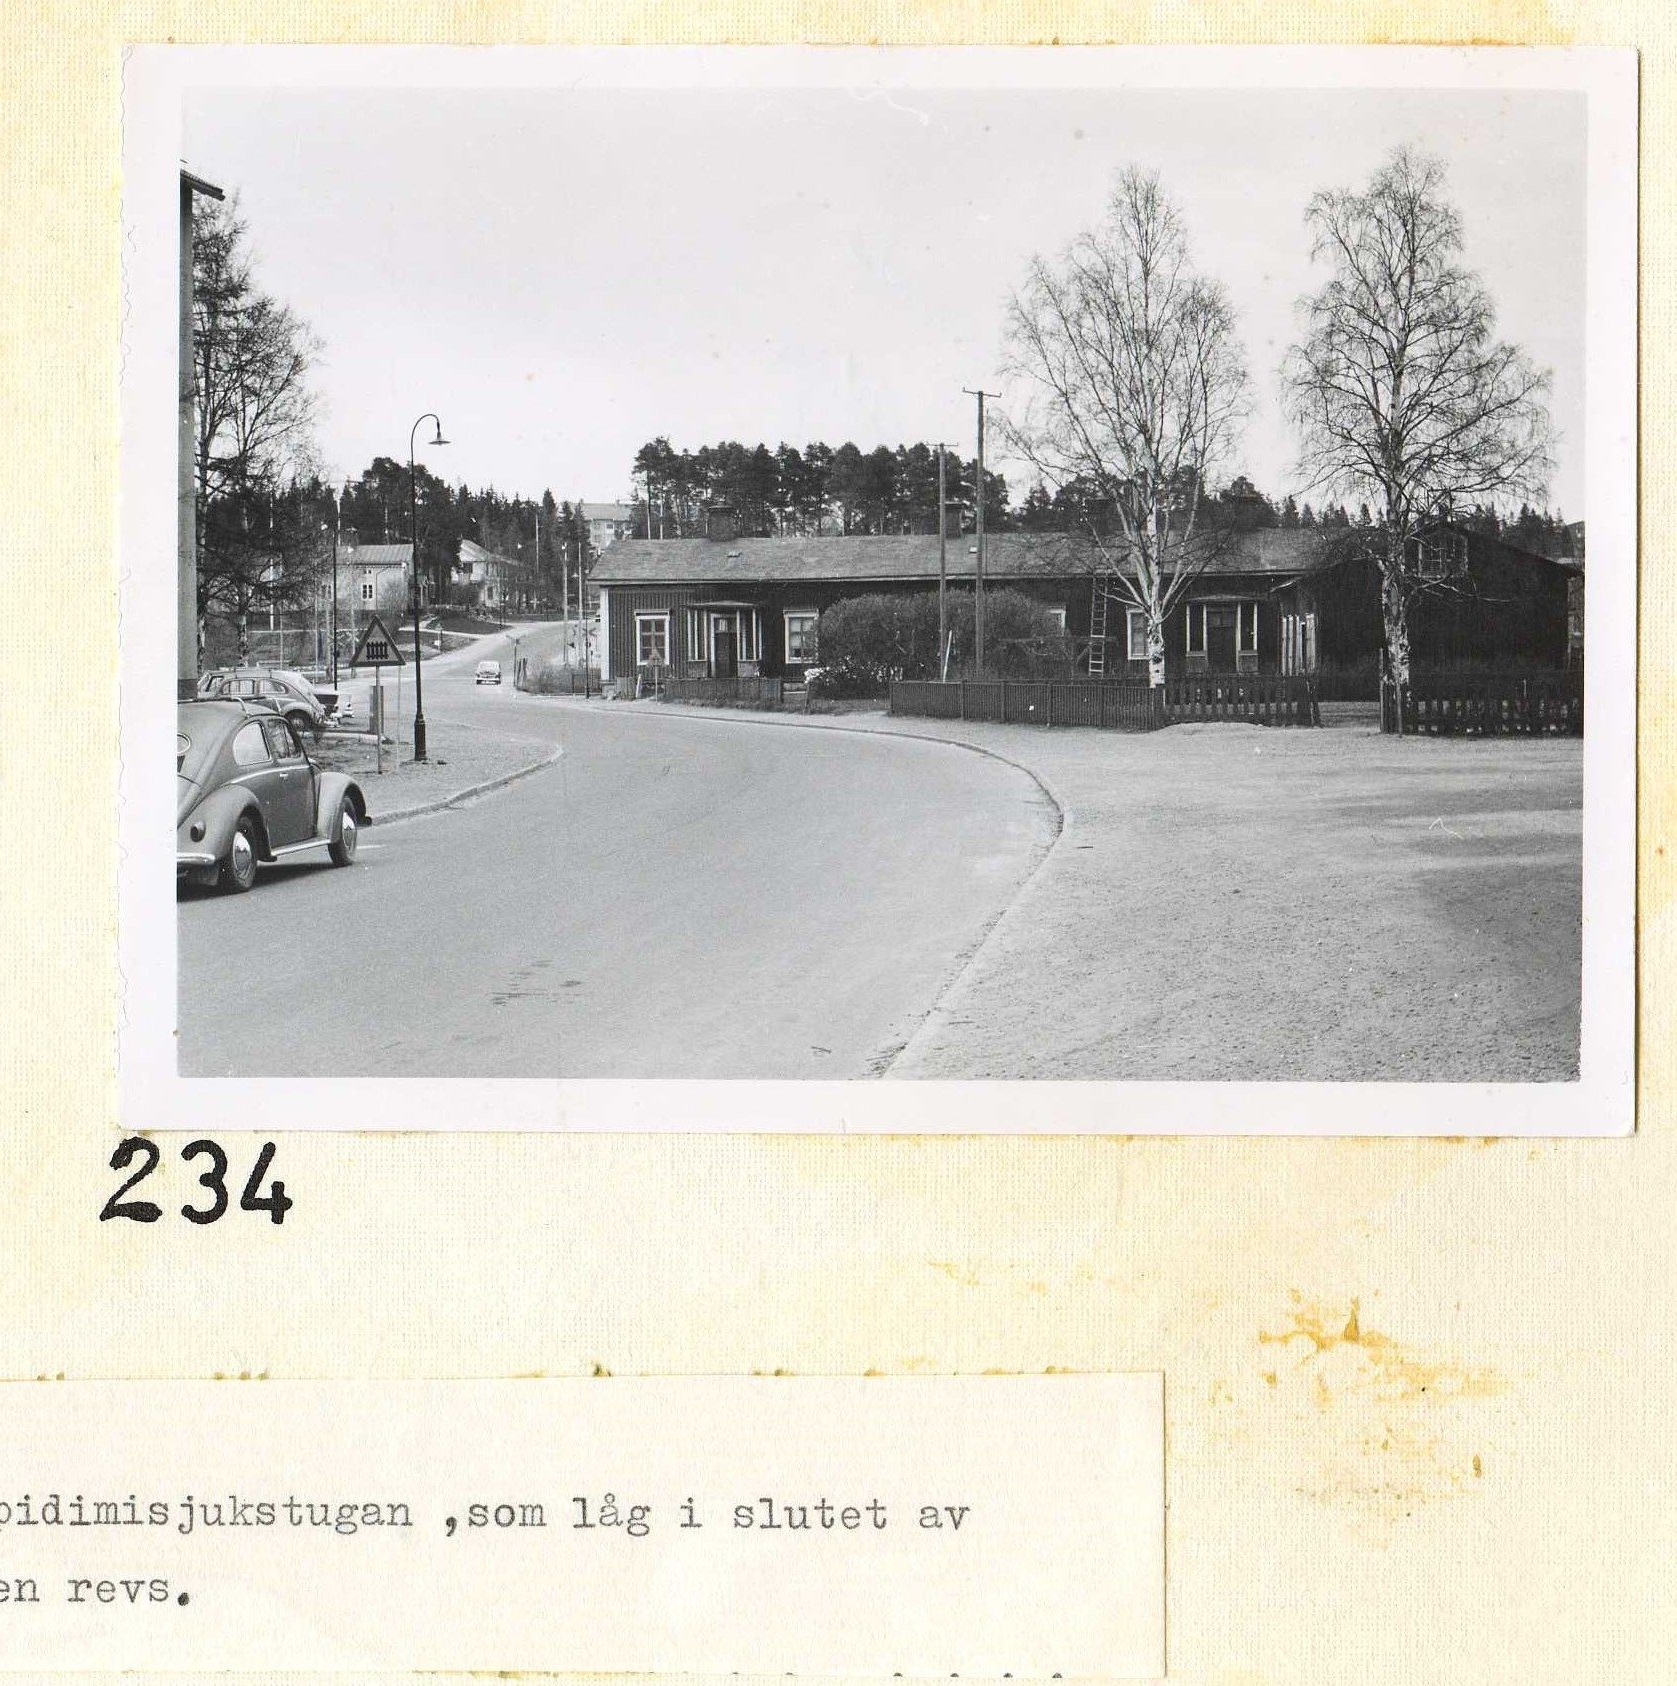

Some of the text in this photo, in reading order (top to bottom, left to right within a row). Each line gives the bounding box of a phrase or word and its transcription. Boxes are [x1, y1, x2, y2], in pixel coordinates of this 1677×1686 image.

[99, 1136, 293, 1225] 234
[572, 1492, 651, 1537] låg
[680, 1497, 703, 1528] i
[733, 1497, 887, 1530] slutet
[919, 1506, 970, 1531] av
[67, 1578, 190, 1607] revs.
